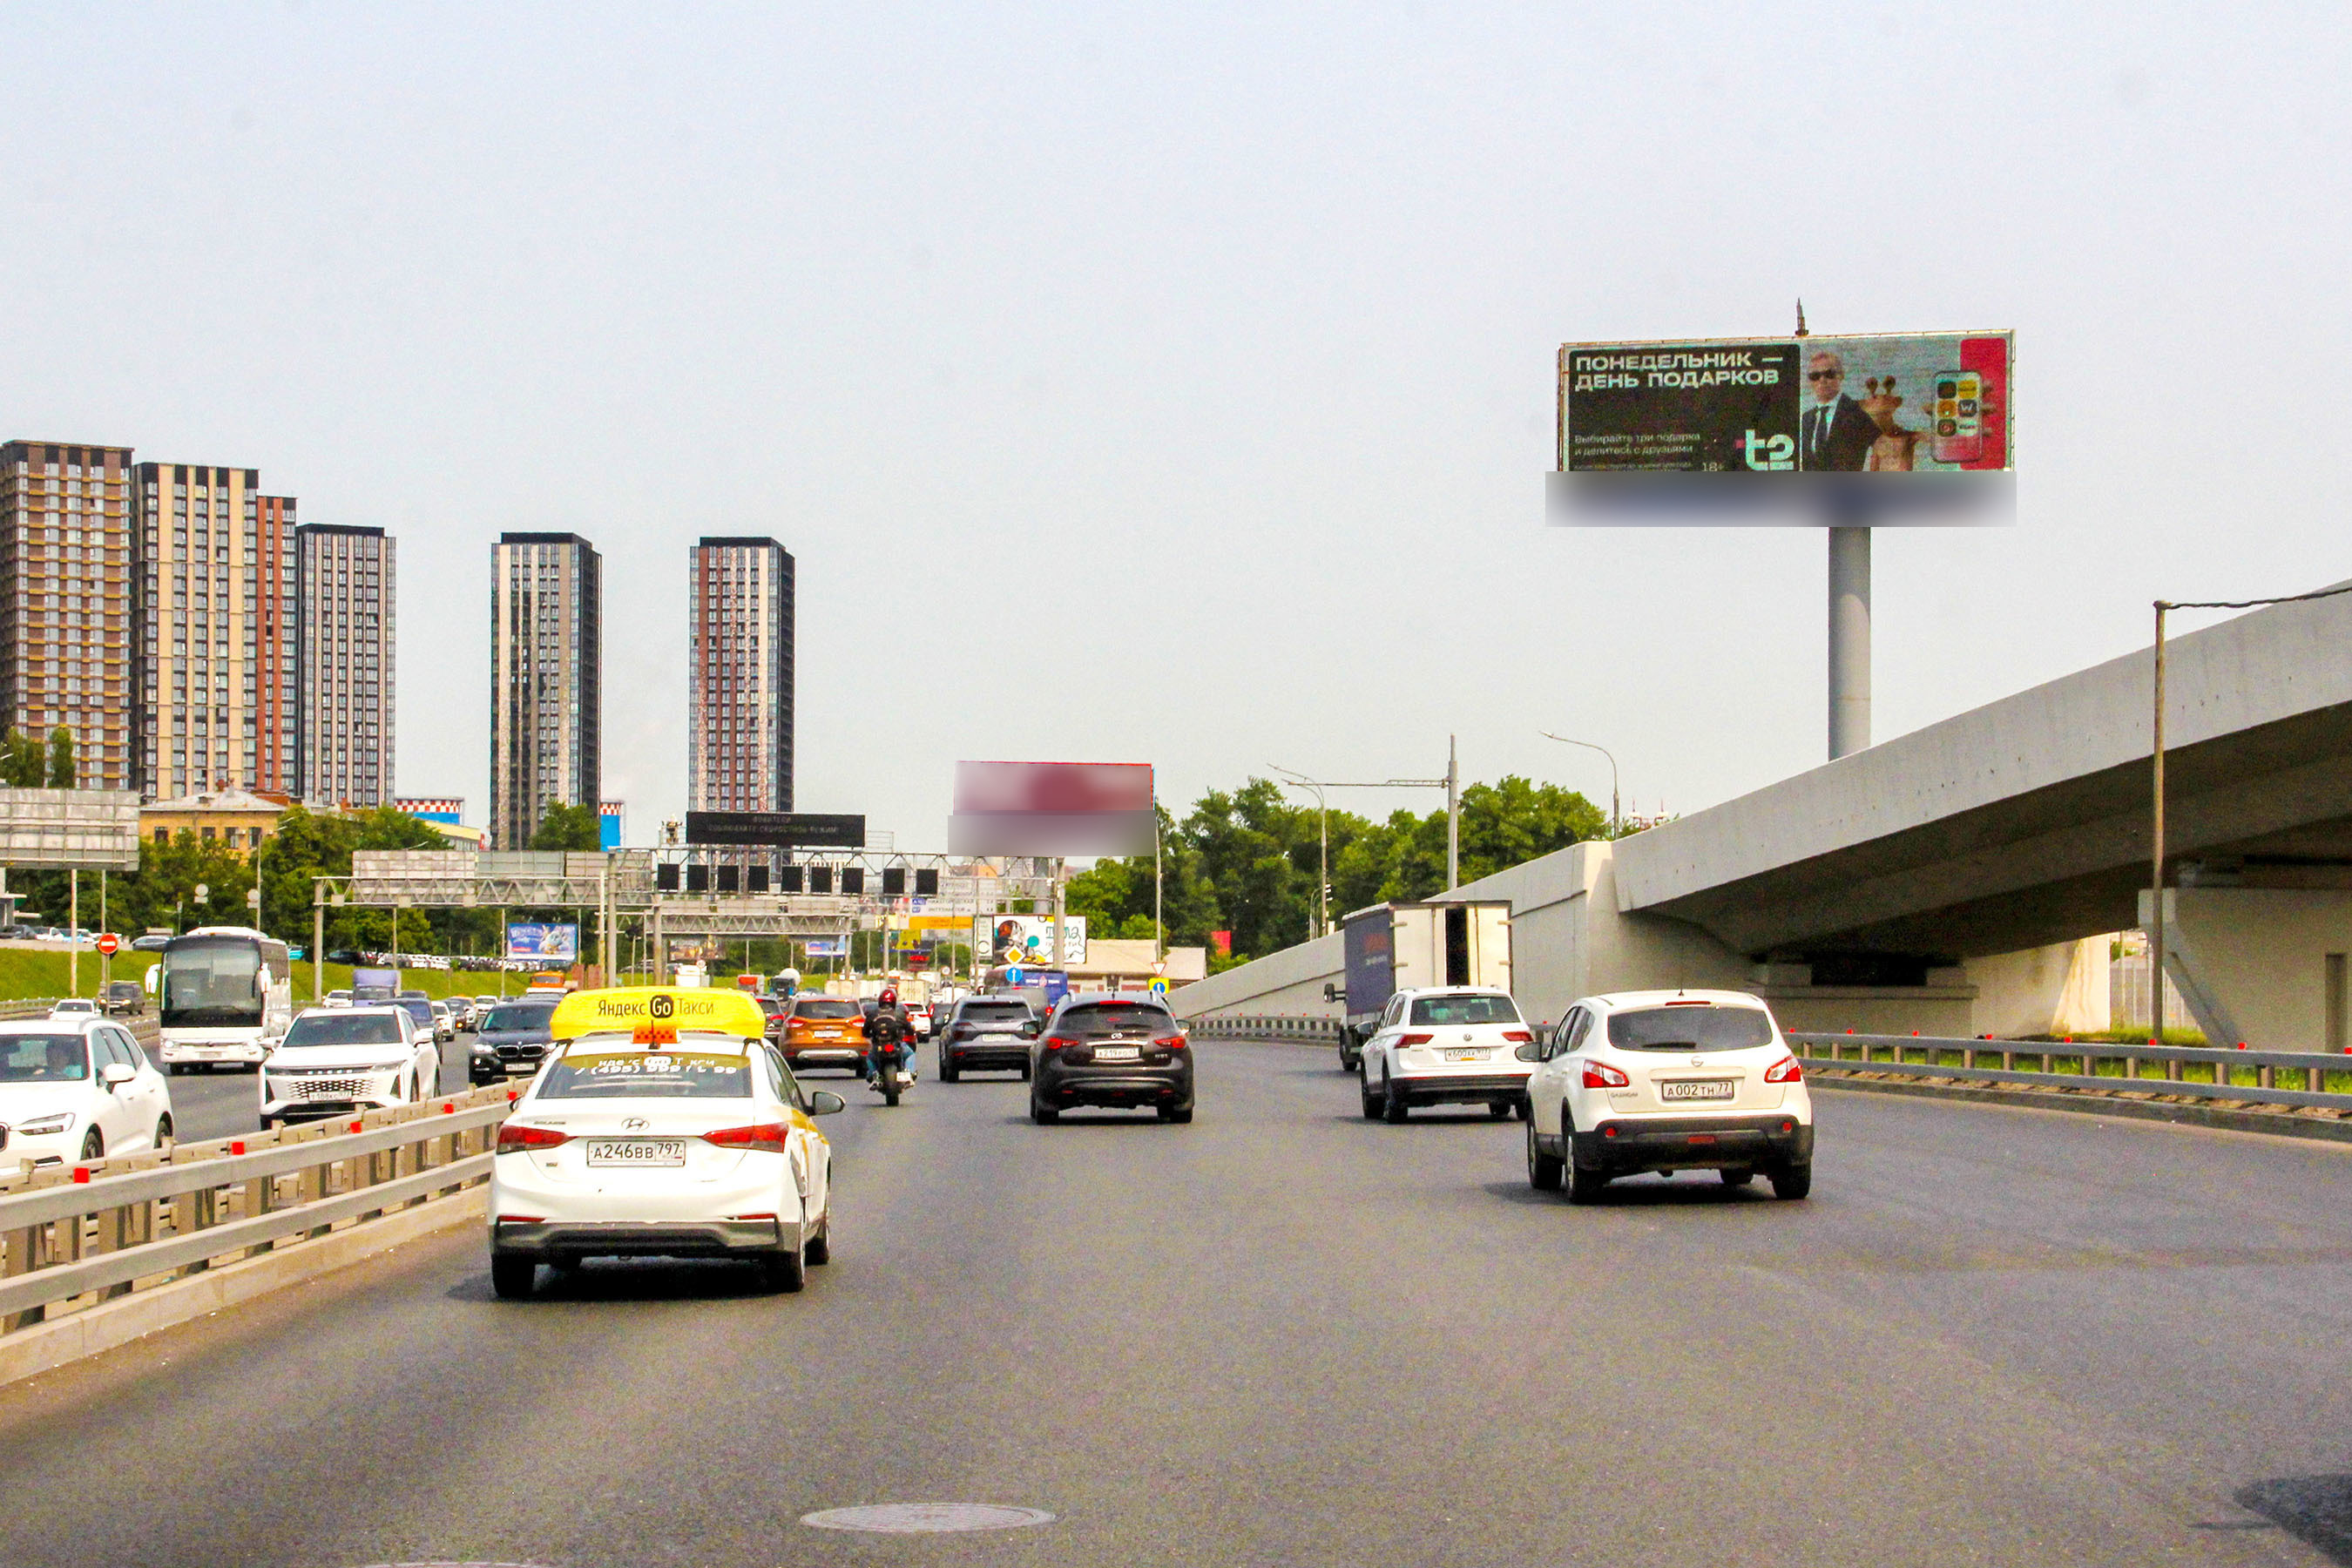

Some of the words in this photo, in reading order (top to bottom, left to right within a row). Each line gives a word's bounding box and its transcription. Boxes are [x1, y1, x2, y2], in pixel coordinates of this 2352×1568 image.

[1576, 352, 1753, 372] ПОНЕДЕЛЬНИК
[1575, 374, 1639, 392] ДЕНЬ
[1648, 369, 1780, 389] ПОДАРКОВ
[1574, 435, 1633, 444] Выбирайте
[1657, 433, 1701, 443] подарка
[598, 1000, 645, 1017] Яндекс
[652, 998, 672, 1015] Go
[678, 997, 714, 1015] Такси
[1718, 1083, 1729, 1093] 77
[593, 1143, 653, 1159] А246ВВ
[657, 1143, 682, 1156] 797
